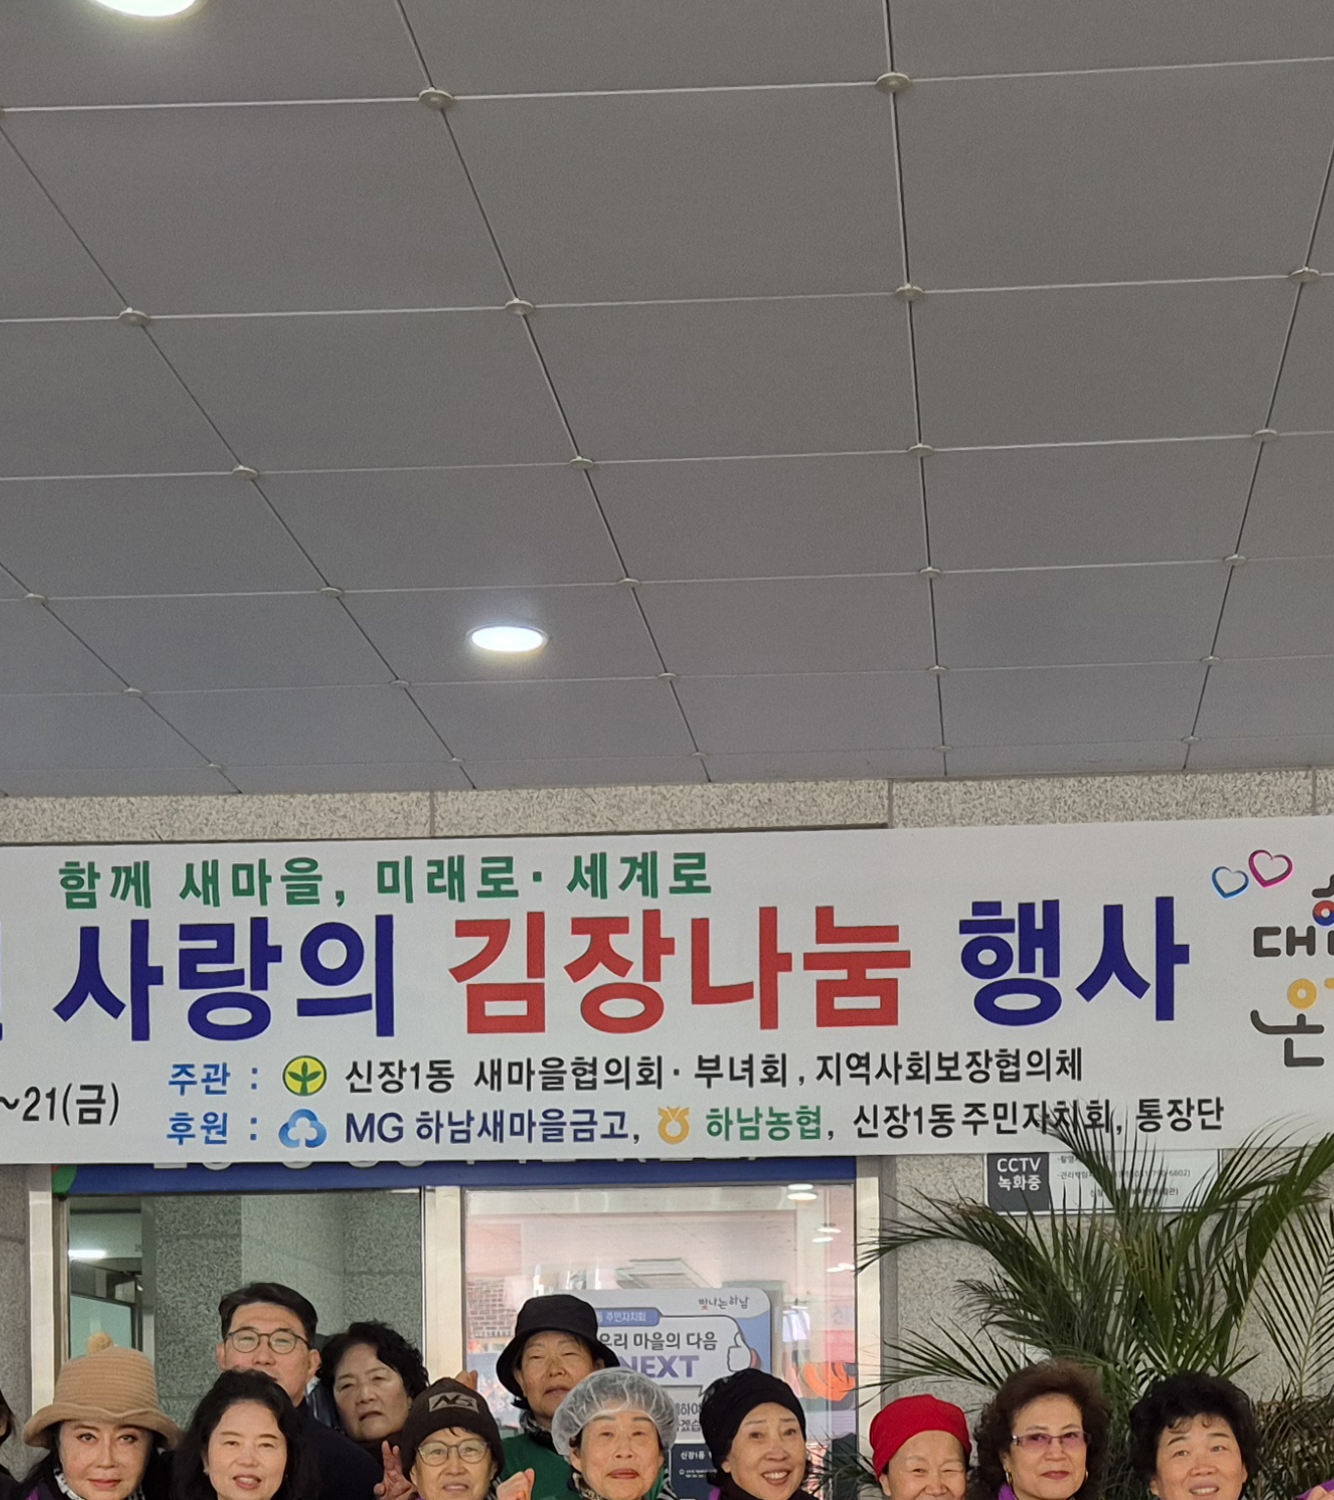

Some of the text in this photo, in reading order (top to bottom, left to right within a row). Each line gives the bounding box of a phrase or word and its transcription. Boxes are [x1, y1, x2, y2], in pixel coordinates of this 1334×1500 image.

[58, 859, 152, 910] 함께
[178, 856, 345, 908] 새마을,
[566, 850, 712, 900] 세계로
[52, 913, 395, 1042] 사랑의
[448, 905, 912, 1035] 김장나눔
[958, 895, 1191, 1027] 행사
[167, 1061, 231, 1097] 주관
[344, 1059, 455, 1095] 신장1동
[815, 1046, 1082, 1087] 지역사회보장협의체
[166, 1111, 228, 1146] 후원
[345, 1111, 404, 1144] MG
[415, 1108, 640, 1145] 하남새마을금고,
[705, 1105, 834, 1142] 하남농협,
[852, 1103, 956, 1140] 신장1동
[1136, 1097, 1225, 1134] 통장단
[997, 1157, 1042, 1173] CCTV
[997, 1175, 1042, 1192] 녹화중
[633, 1331, 680, 1350] 마을의
[687, 1331, 718, 1350] 다음
